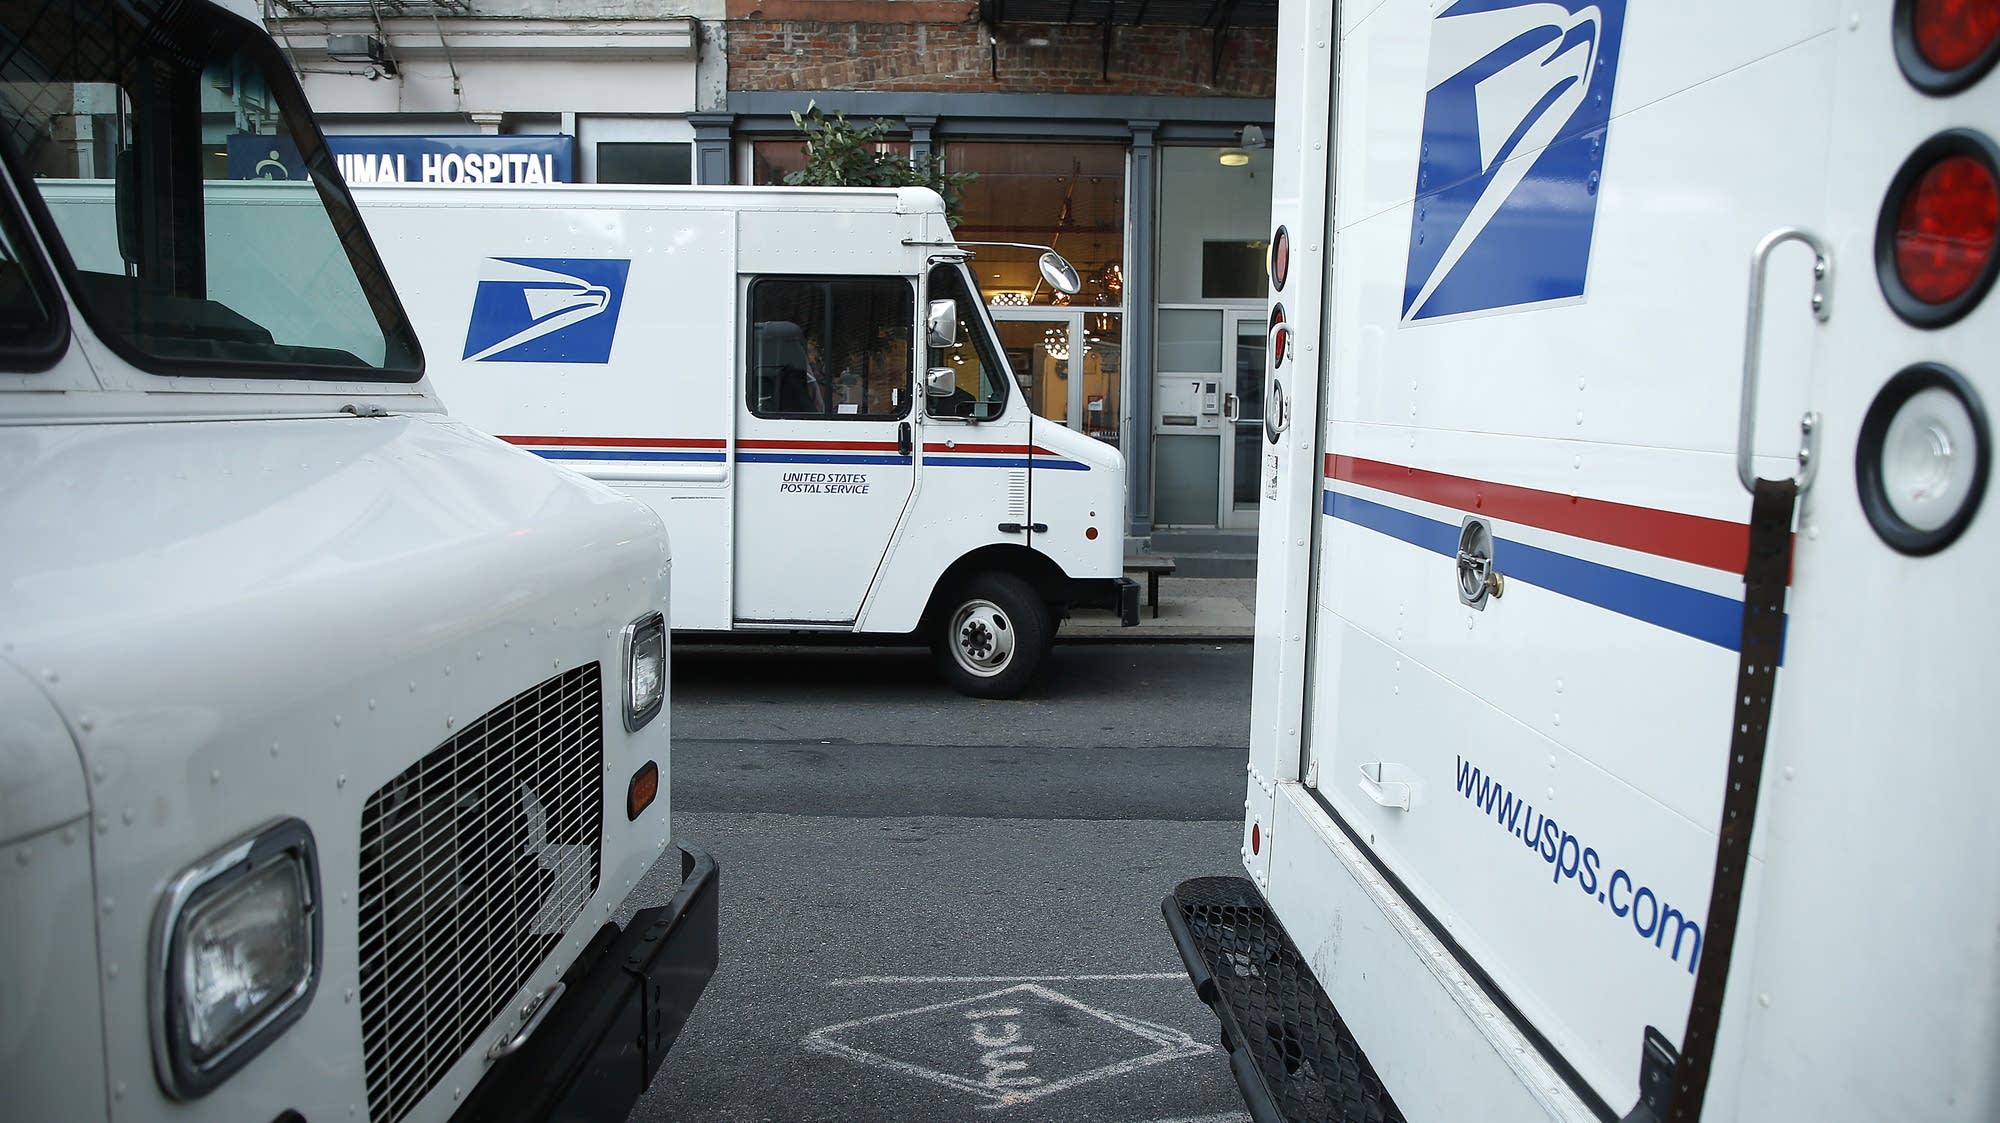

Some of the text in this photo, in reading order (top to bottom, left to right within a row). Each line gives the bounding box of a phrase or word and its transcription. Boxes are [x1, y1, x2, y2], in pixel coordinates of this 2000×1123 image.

[307, 153, 563, 183] IMAL HOSPITAL
[1192, 382, 1200, 393] 7
[782, 472, 867, 483] UNITED STATES
[780, 483, 869, 494] POSTAL SERVICE
[1456, 754, 1702, 975] www.usps.com
